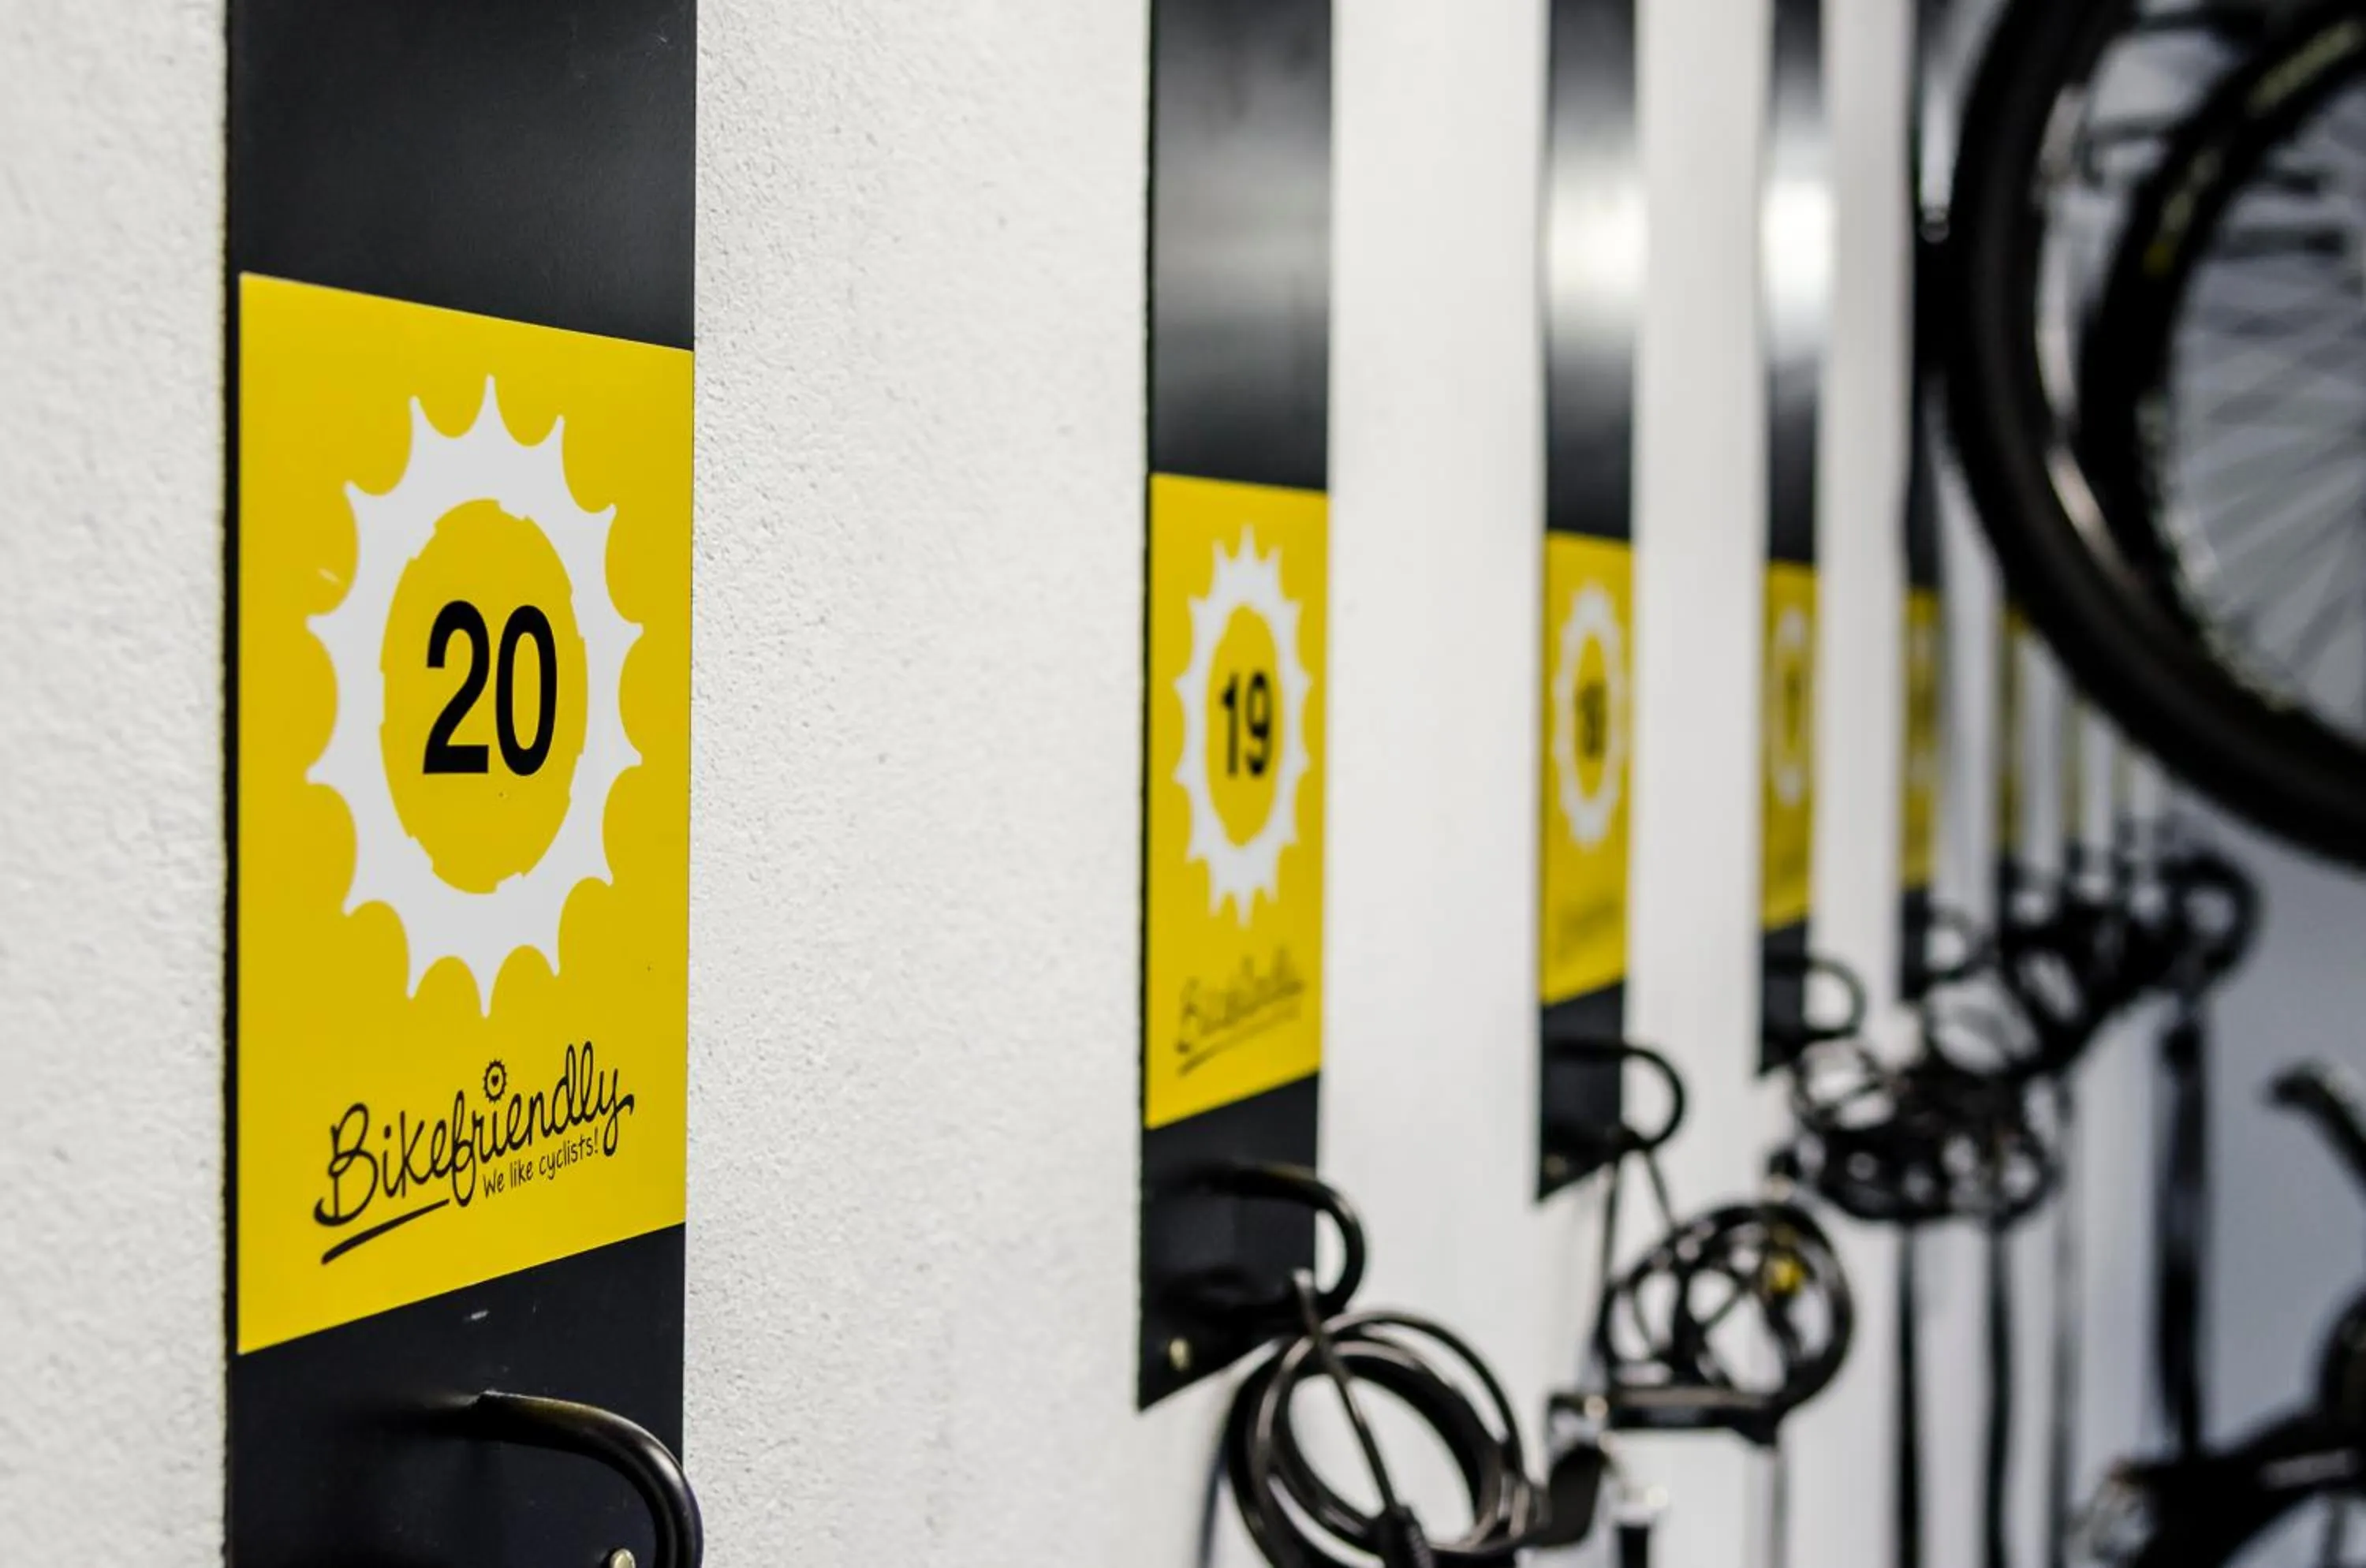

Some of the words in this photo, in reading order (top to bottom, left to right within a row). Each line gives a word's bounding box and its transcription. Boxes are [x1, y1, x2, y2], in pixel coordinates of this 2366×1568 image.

[423, 599, 558, 776] 20
[1221, 672, 1273, 777] 19
[313, 1040, 636, 1227] Bikefriendly
[483, 1168, 505, 1199] We
[509, 1158, 534, 1188] like
[539, 1126, 599, 1180] cyclists!
